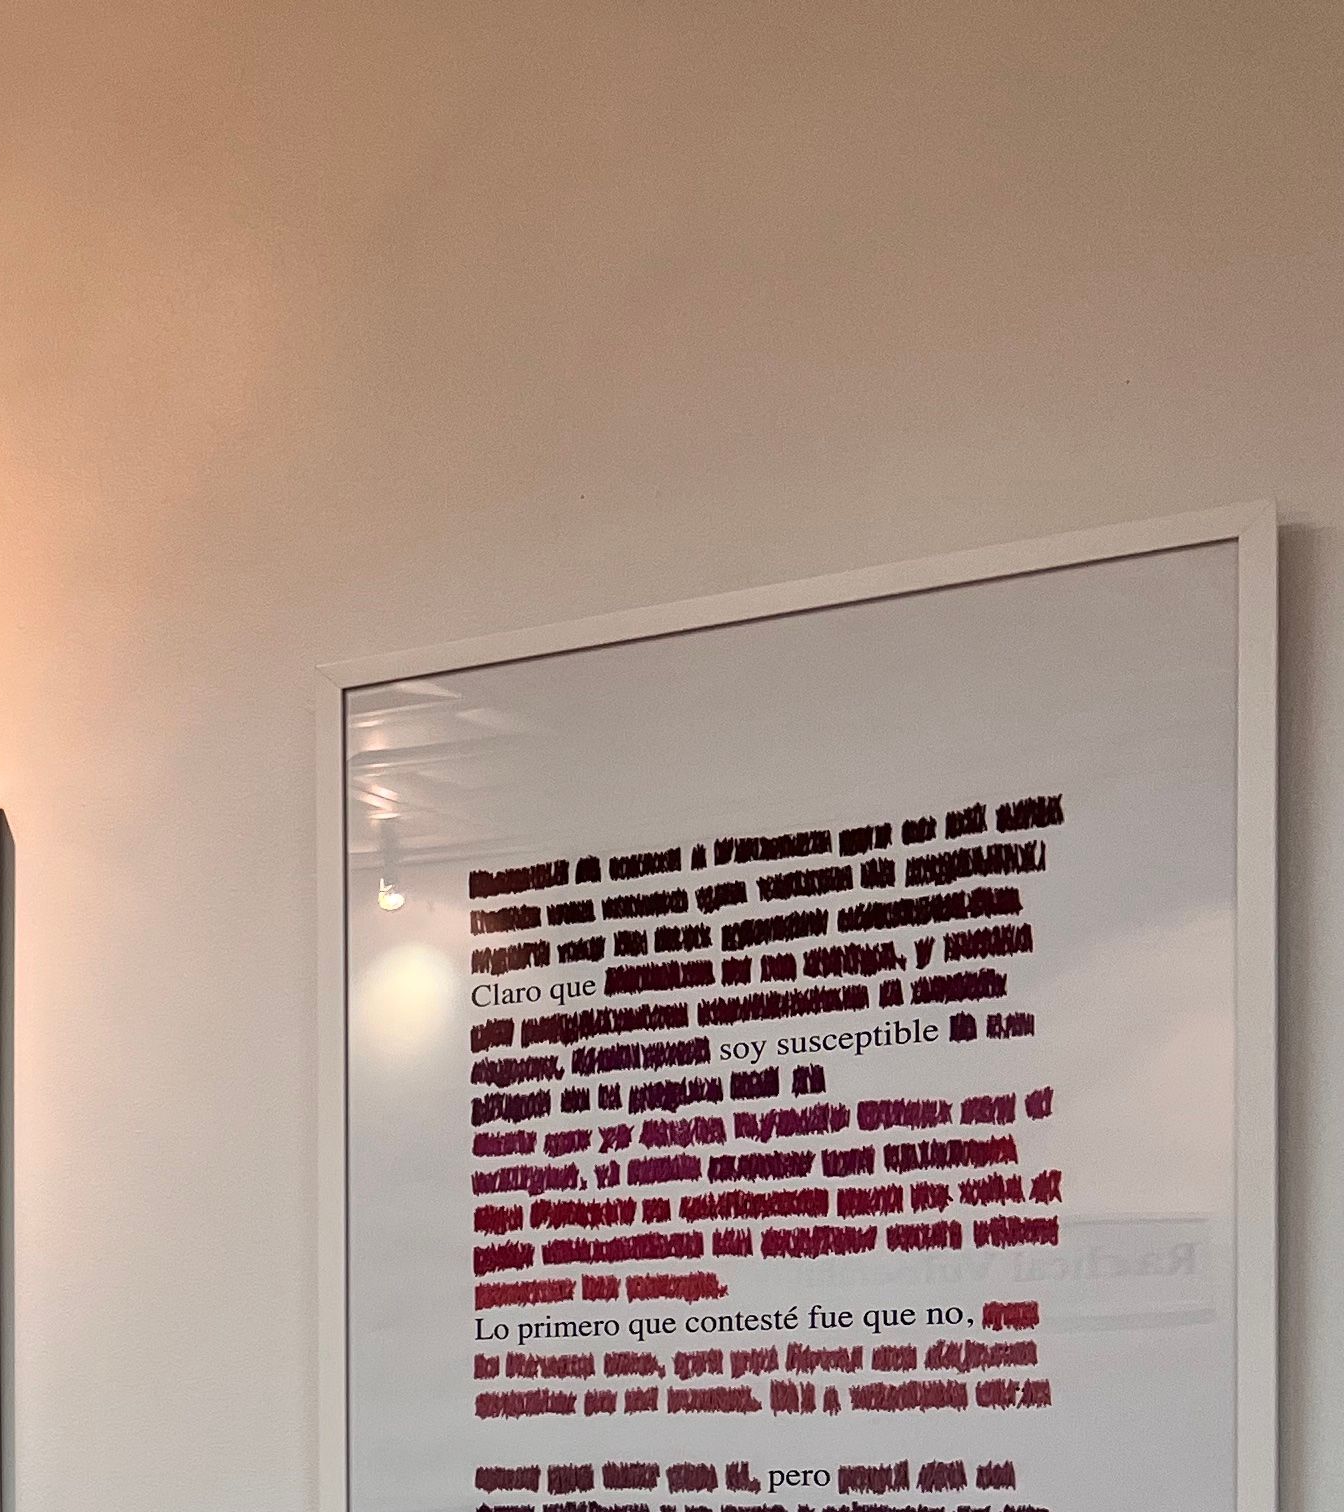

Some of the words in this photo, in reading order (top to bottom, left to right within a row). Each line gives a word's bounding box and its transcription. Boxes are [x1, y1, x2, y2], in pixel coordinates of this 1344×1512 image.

[471, 983, 542, 1008] Claro
[549, 979, 597, 1006] que
[719, 1040, 767, 1065] soy
[775, 1018, 939, 1057] susceptible
[474, 1318, 510, 1341] Lo
[517, 1315, 620, 1346] primero
[628, 1317, 677, 1342] que
[685, 1305, 799, 1333] contesté
[807, 1304, 854, 1330] fue
[863, 1308, 917, 1335] que
[925, 1306, 974, 1328] no,
[767, 1469, 831, 1494] pero
